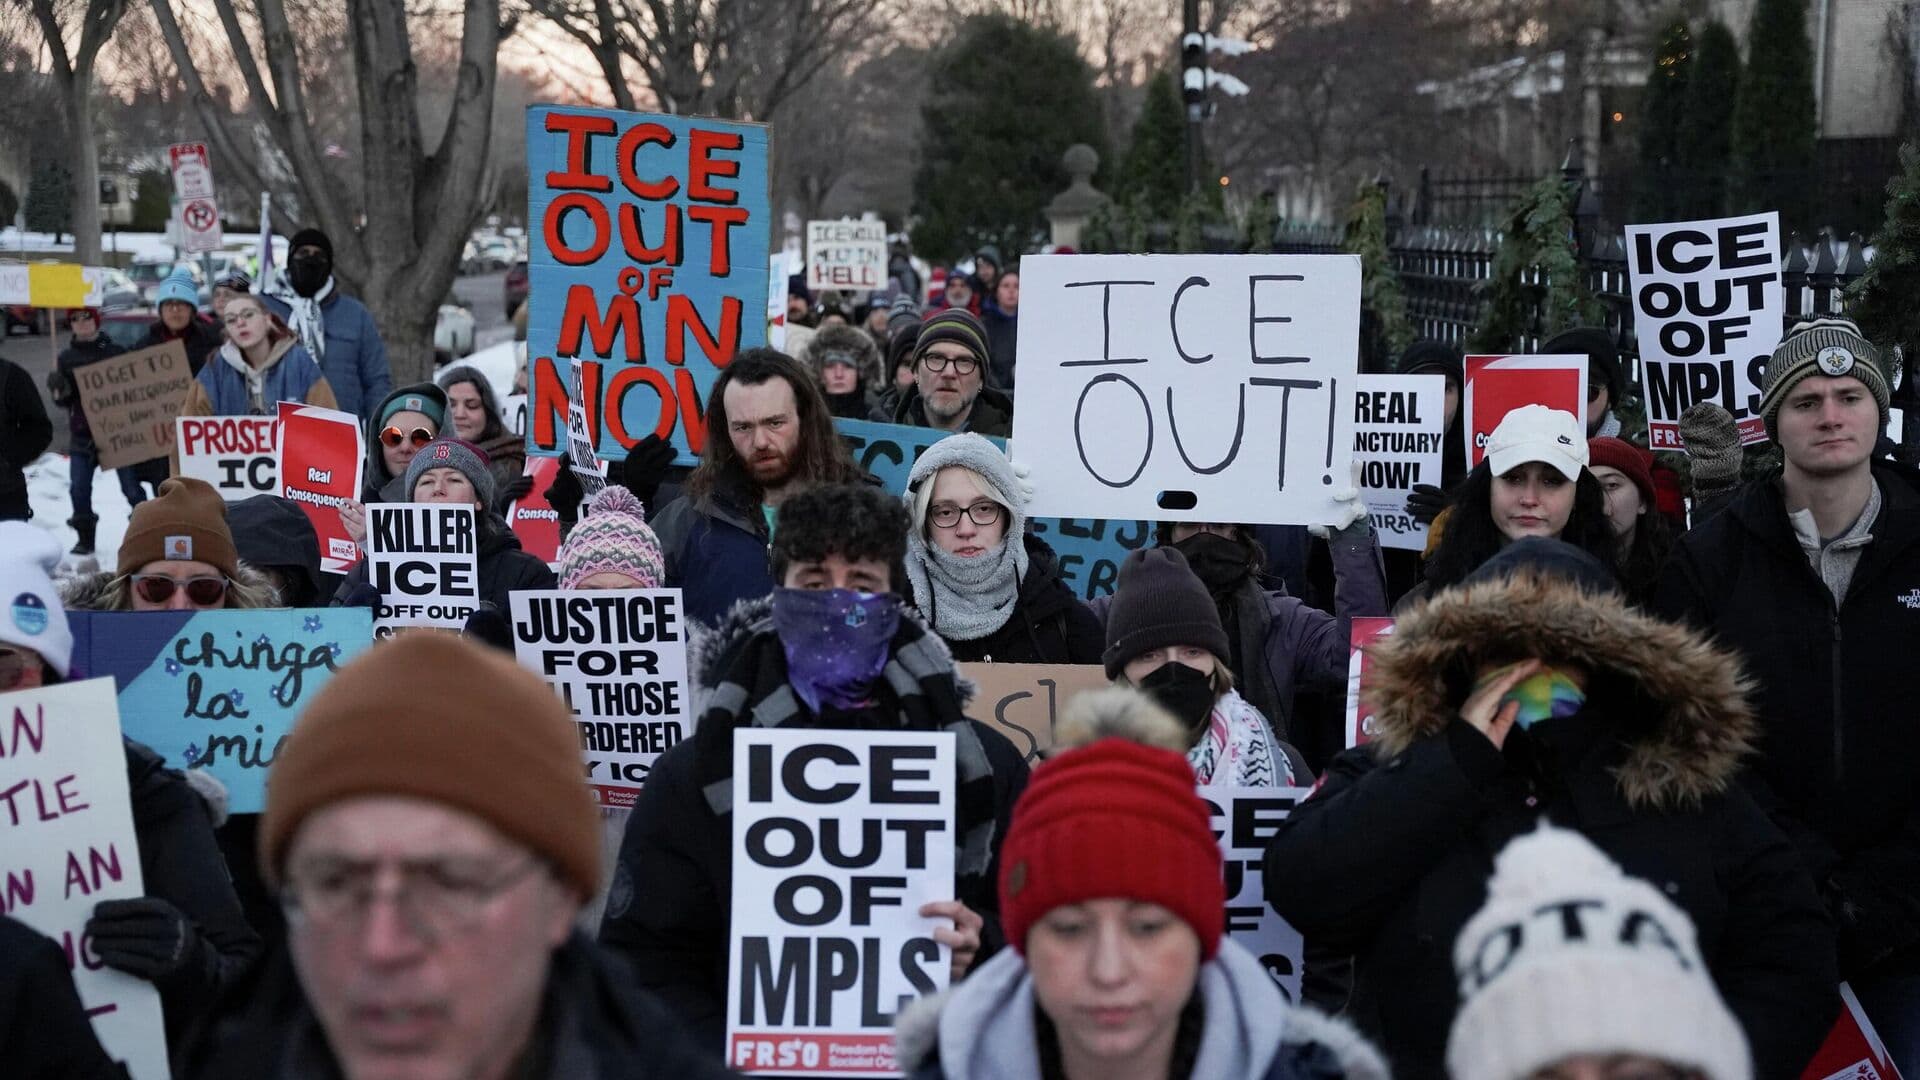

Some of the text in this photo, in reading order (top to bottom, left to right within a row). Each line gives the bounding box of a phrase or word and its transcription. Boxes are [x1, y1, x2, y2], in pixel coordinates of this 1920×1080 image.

[545, 112, 743, 204] ICE
[543, 192, 750, 277] OUT
[1635, 222, 1772, 275] ICE
[618, 266, 674, 300] OF
[814, 263, 876, 287] HELL
[1639, 272, 1777, 318] OUT
[556, 284, 742, 369] MN
[1060, 275, 1310, 367] ICE
[1659, 316, 1751, 357] OF
[81, 352, 173, 390] TO GET TO
[568, 408, 585, 436] FOR
[1355, 391, 1422, 424] REAL
[1074, 373, 1337, 491] OUT!
[1353, 431, 1442, 453] NCTUARY
[1653, 427, 1684, 446] FR
[218, 457, 277, 491] IC
[308, 467, 332, 484] Real
[285, 486, 350, 509] Consequence
[371, 508, 474, 554] KILLER
[375, 560, 475, 597] ICE
[379, 604, 474, 620] OFF OUR
[516, 595, 679, 644] JUSTICE
[175, 631, 343, 708] chinga
[542, 649, 660, 677] FOR
[183, 672, 249, 720] la
[586, 680, 681, 716] THOSE
[577, 721, 683, 754] RDERED
[610, 762, 652, 783] IC
[748, 743, 940, 804] ICE
[0, 774, 90, 826] TLE
[745, 816, 946, 870] OUT
[64, 842, 123, 899] AN
[773, 874, 907, 926] OF
[739, 936, 940, 1028] MPLS
